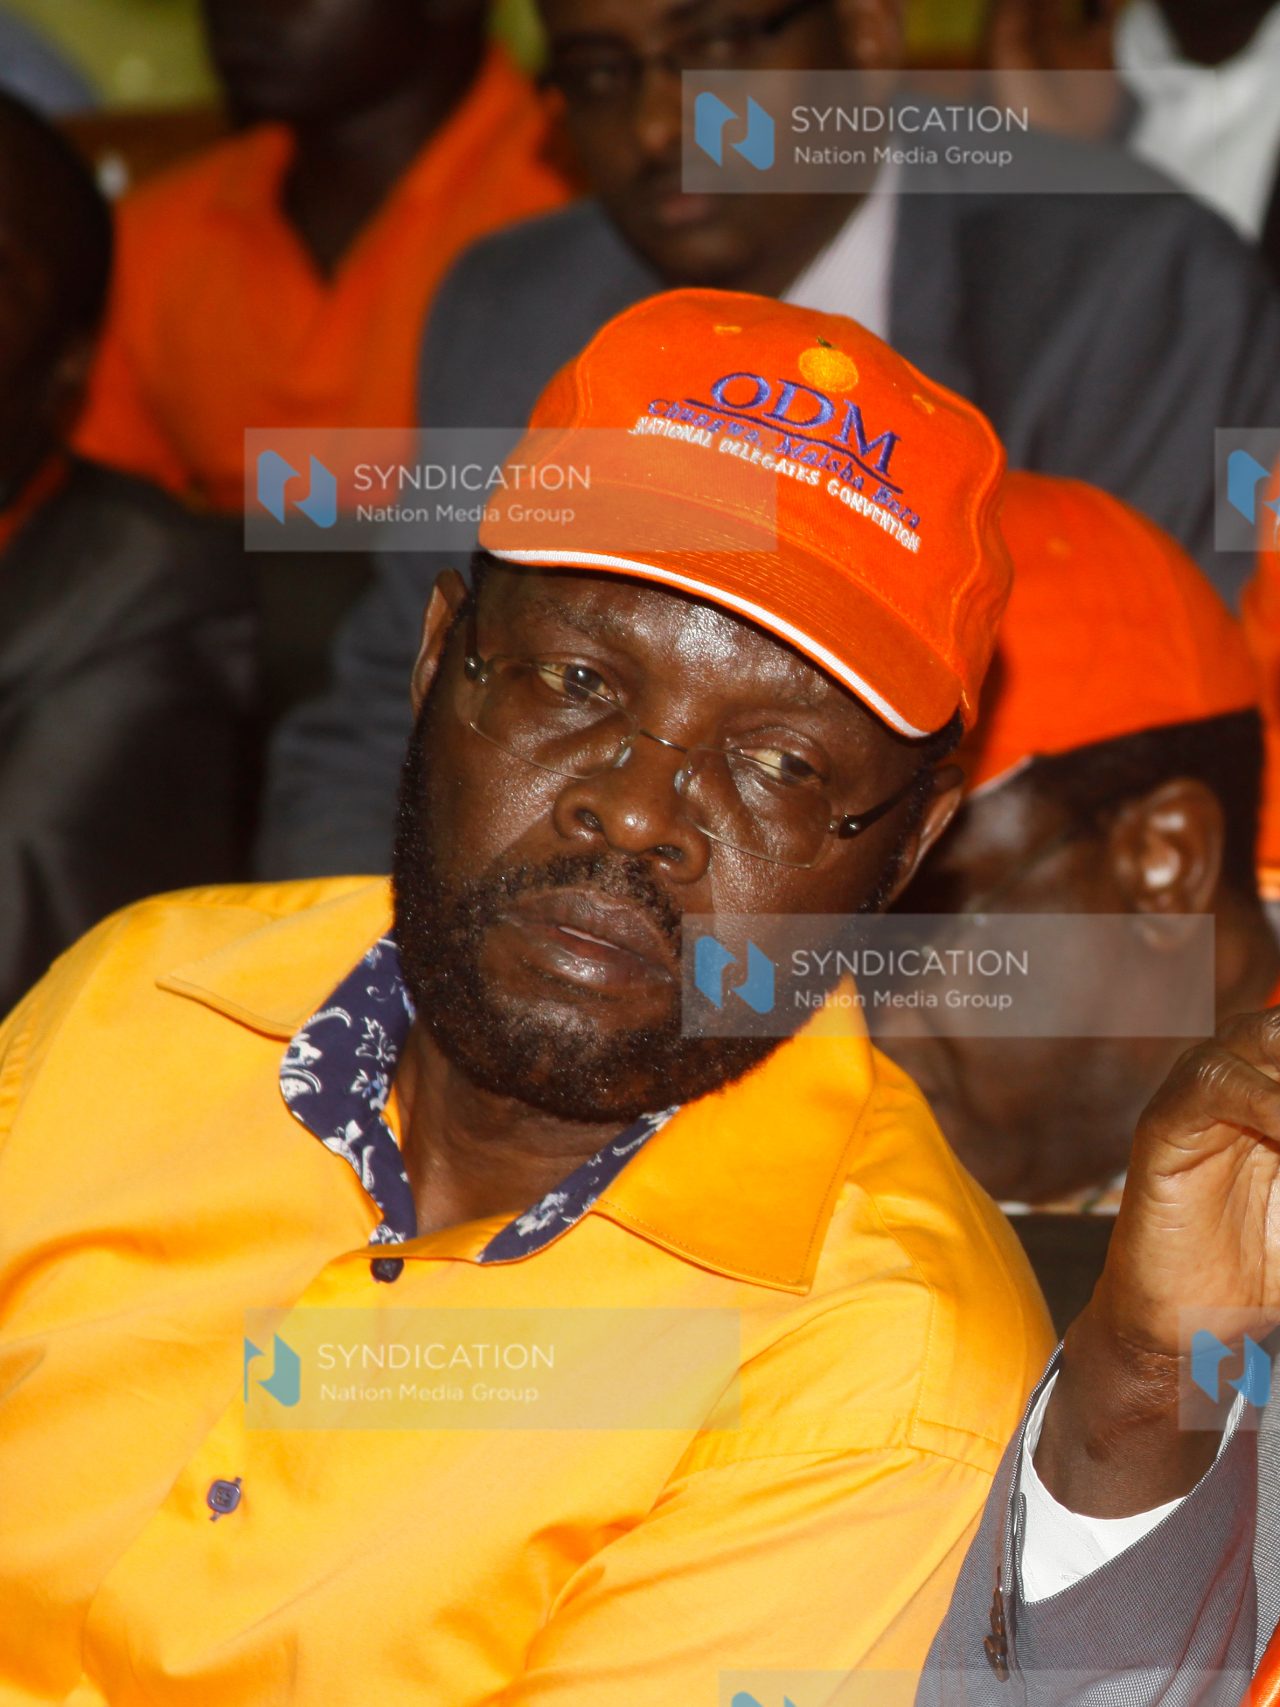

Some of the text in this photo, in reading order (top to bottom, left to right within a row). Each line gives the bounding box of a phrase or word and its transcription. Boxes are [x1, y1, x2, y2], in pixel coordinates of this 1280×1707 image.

[628, 416, 921, 553] NATIONAL DELEGATES CONVENTION
[711, 372, 902, 478] ODM
